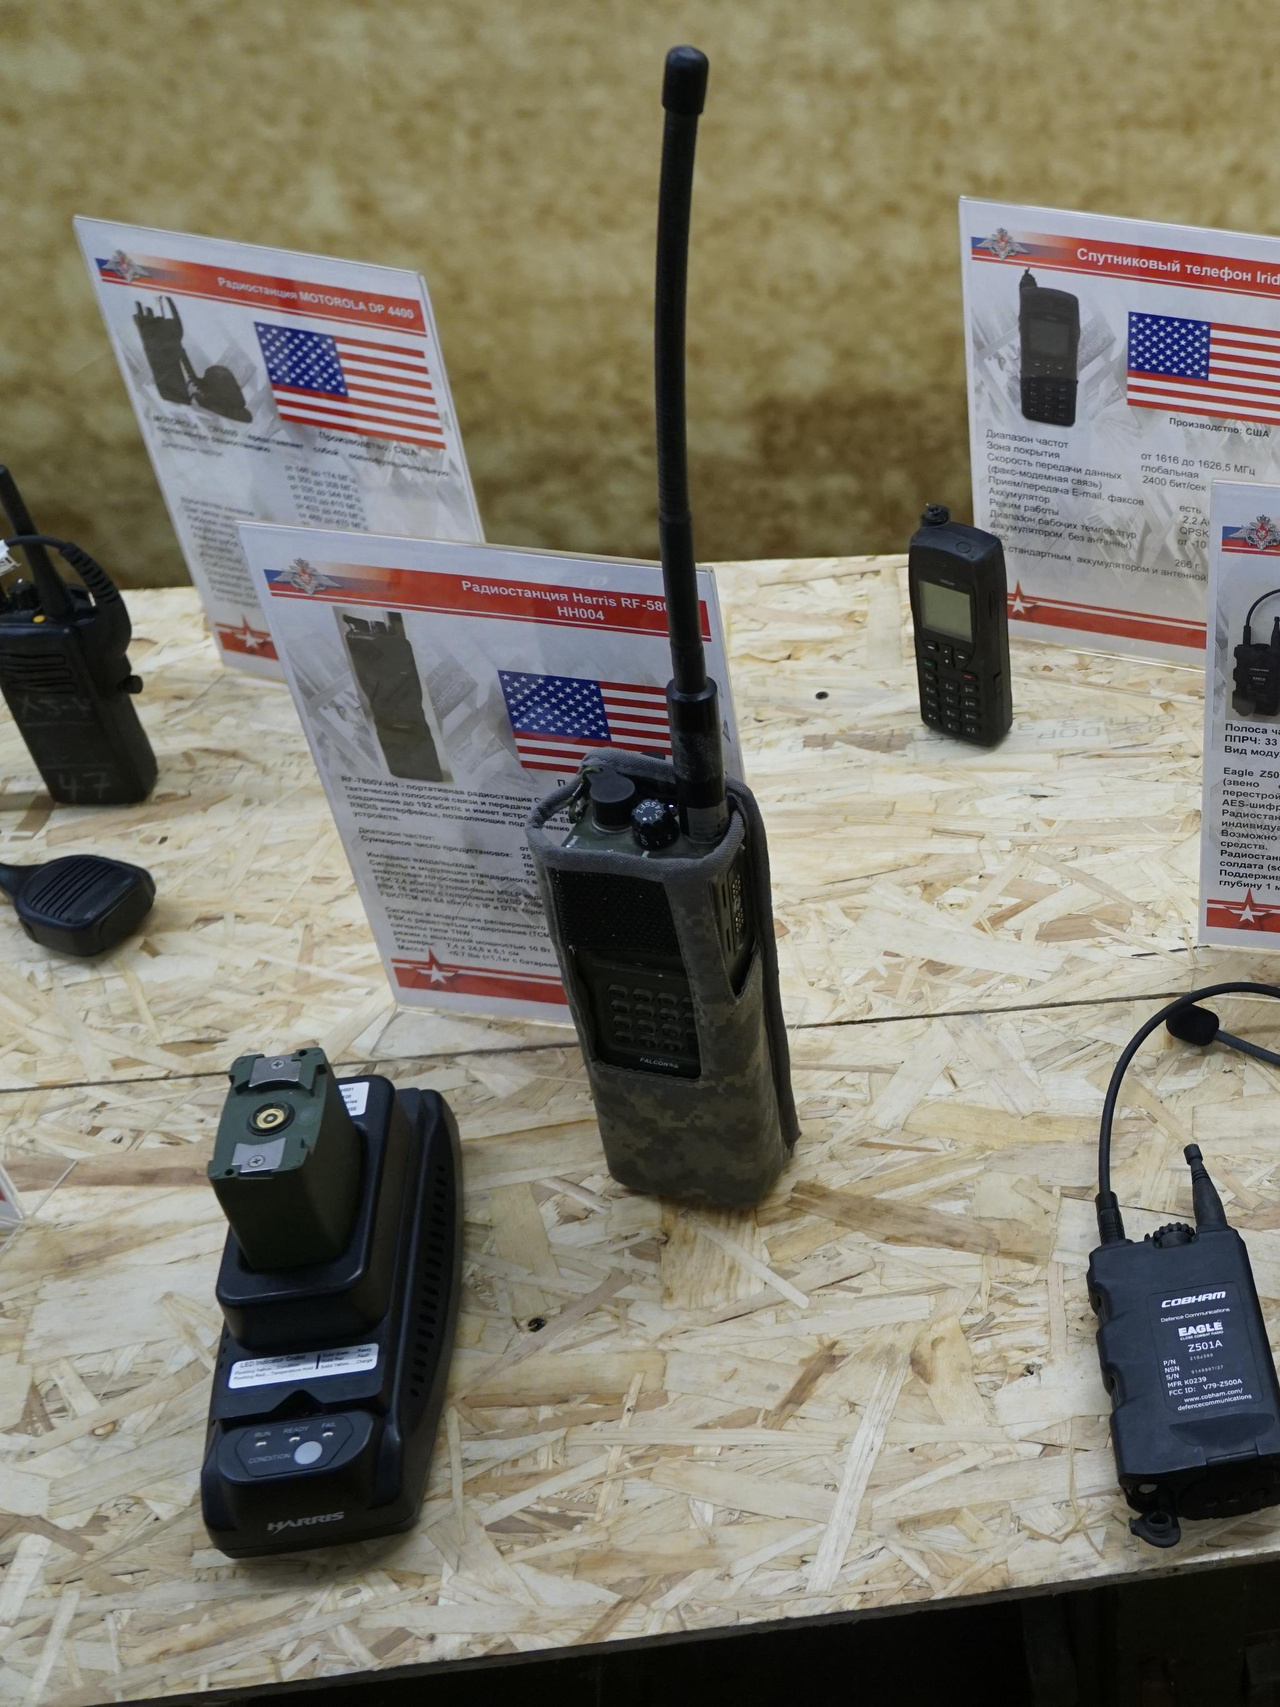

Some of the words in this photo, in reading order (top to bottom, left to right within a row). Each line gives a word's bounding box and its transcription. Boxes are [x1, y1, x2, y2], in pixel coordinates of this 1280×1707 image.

[1077, 248, 1181, 273] Спутниковый
[1185, 264, 1252, 282] телефон
[217, 277, 298, 299] Радиостанция
[299, 291, 367, 311] MOTOROLA
[368, 302, 385, 314] DP
[387, 306, 415, 319] 4400
[461, 580, 569, 602] Радиостанция
[572, 592, 617, 607] Harris
[557, 606, 605, 621] HH004
[1225, 723, 1268, 734] Полоса
[1224, 734, 1261, 745] ППРЧ:
[1224, 745, 1248, 756] Вид
[1223, 767, 1254, 778] Eagle
[1223, 778, 1260, 788] (звено
[1220, 829, 1278, 841] Возможно
[1220, 841, 1268, 851] средств.
[1219, 861, 1264, 870] солдата
[1219, 880, 1262, 891] глубину
[1161, 1291, 1226, 1308] COBHAM
[1160, 1315, 1184, 1323] Defence
[1184, 1308, 1230, 1319] Communications
[1178, 1321, 1223, 1337] EAGLE
[1188, 1339, 1223, 1353] Z501A
[1164, 1365, 1180, 1373] NSN
[1165, 1373, 1180, 1381] S/N
[1167, 1380, 1183, 1388] MFR
[1184, 1376, 1207, 1385] K0239
[1168, 1388, 1183, 1396] FCC
[1184, 1386, 1196, 1394] ID:
[1202, 1378, 1243, 1390] V79-Z500A
[1184, 1387, 1243, 1403] www.cobham.com/
[1177, 1394, 1252, 1411] defencecommunications
[267, 1511, 344, 1535] HARRIS
